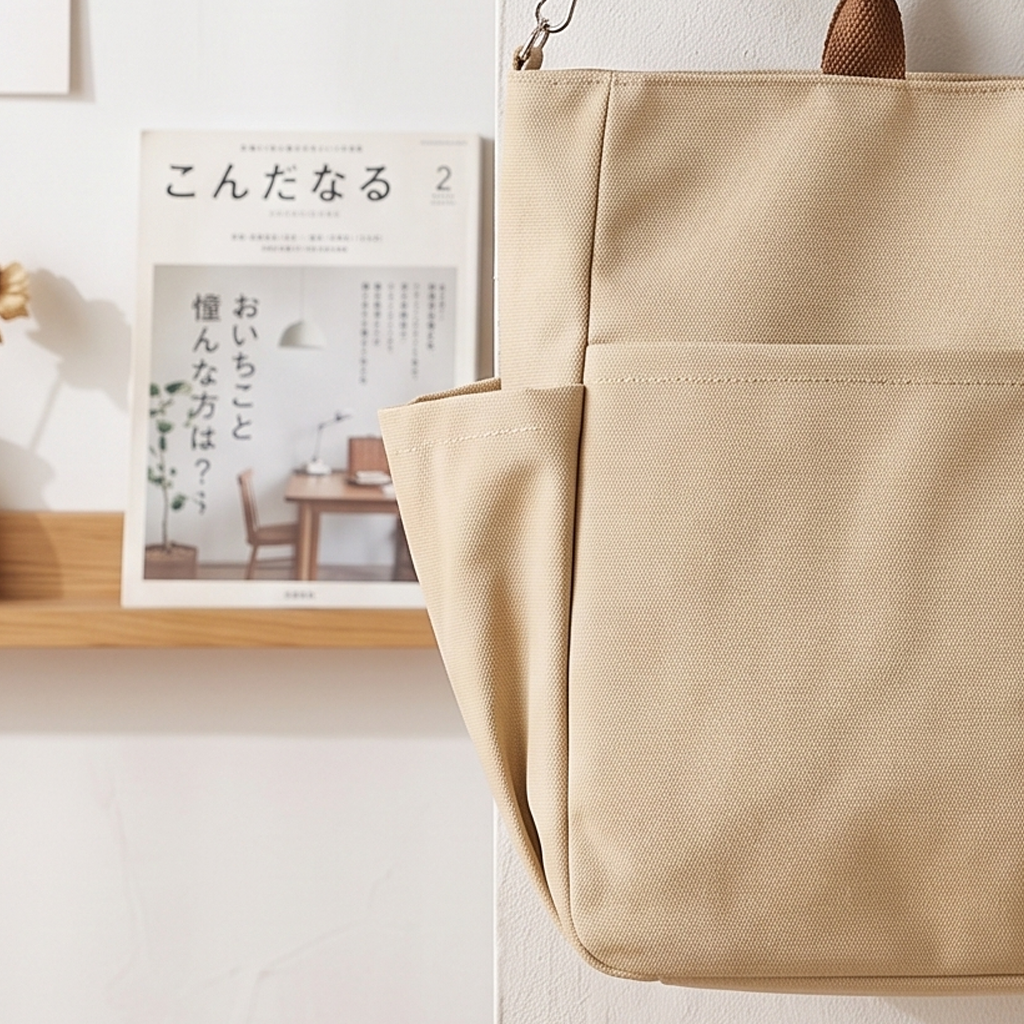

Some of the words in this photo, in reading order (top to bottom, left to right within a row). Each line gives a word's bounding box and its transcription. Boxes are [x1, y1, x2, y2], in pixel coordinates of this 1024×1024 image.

[165, 162, 392, 203] こんだなる
[435, 164, 453, 192] 2
[230, 294, 260, 442] おいちこと
